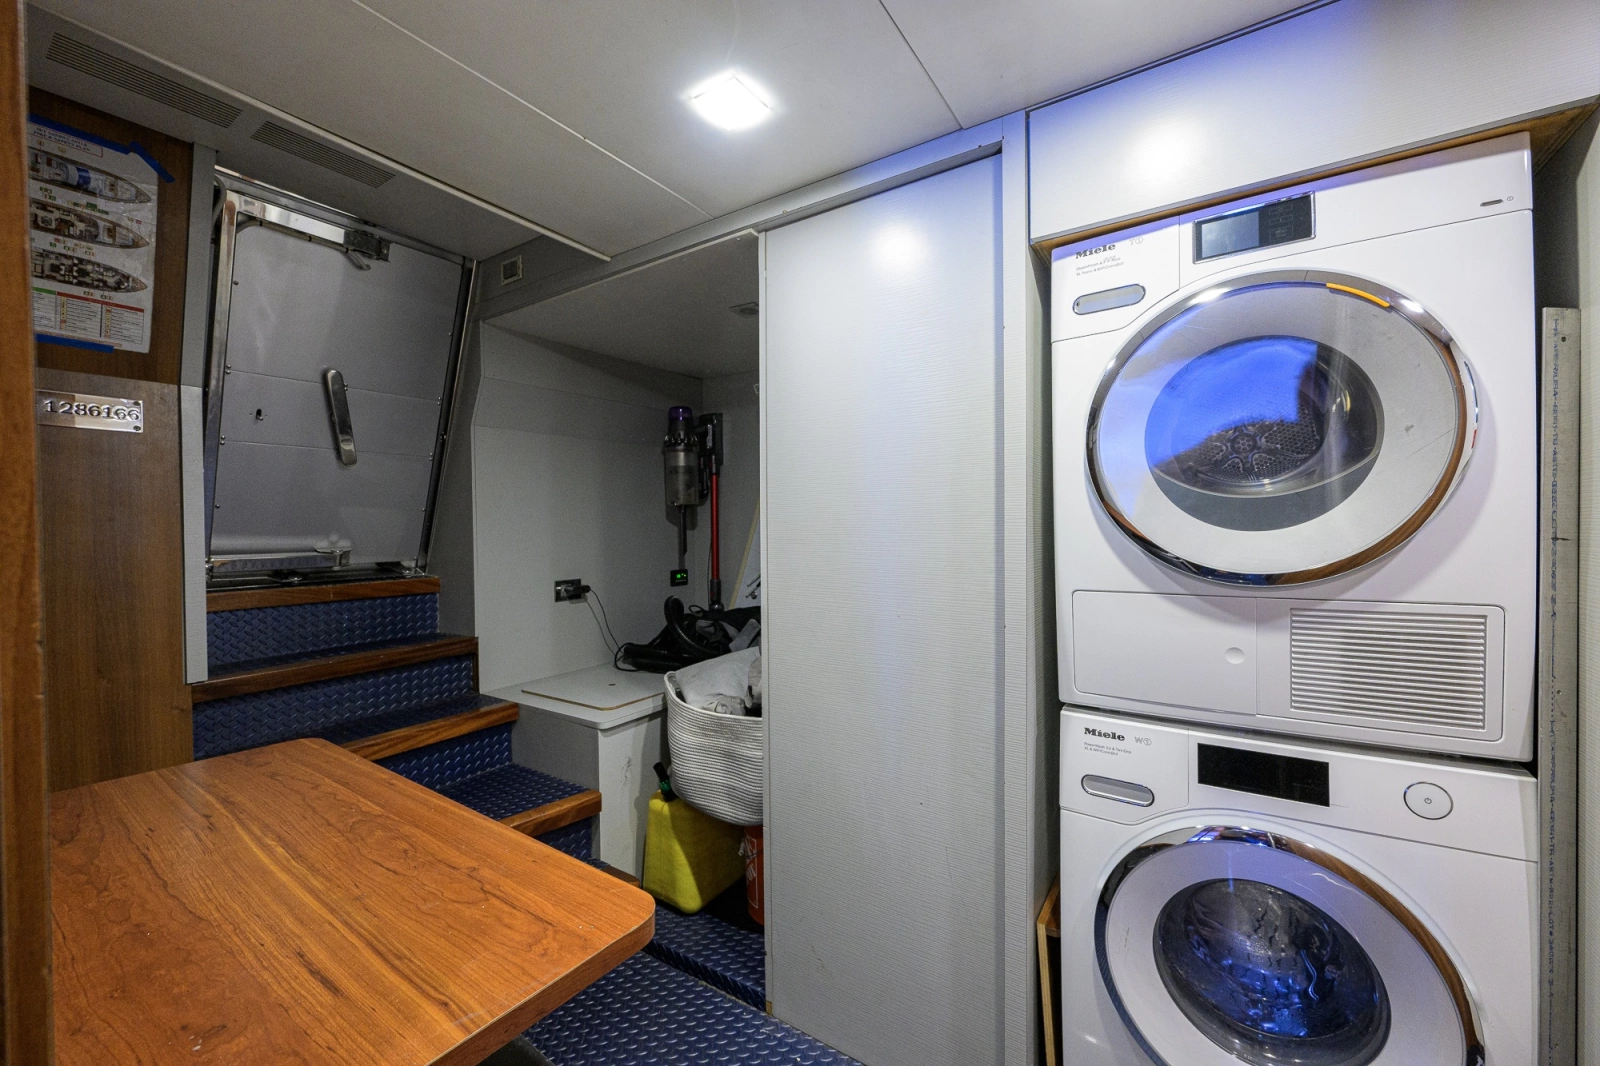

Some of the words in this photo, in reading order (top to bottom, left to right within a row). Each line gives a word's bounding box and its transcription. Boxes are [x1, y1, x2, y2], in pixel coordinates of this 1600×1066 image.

[1075, 244, 1116, 259] Miele
[44, 399, 140, 421] 1286166
[1084, 727, 1126, 741] Miele
